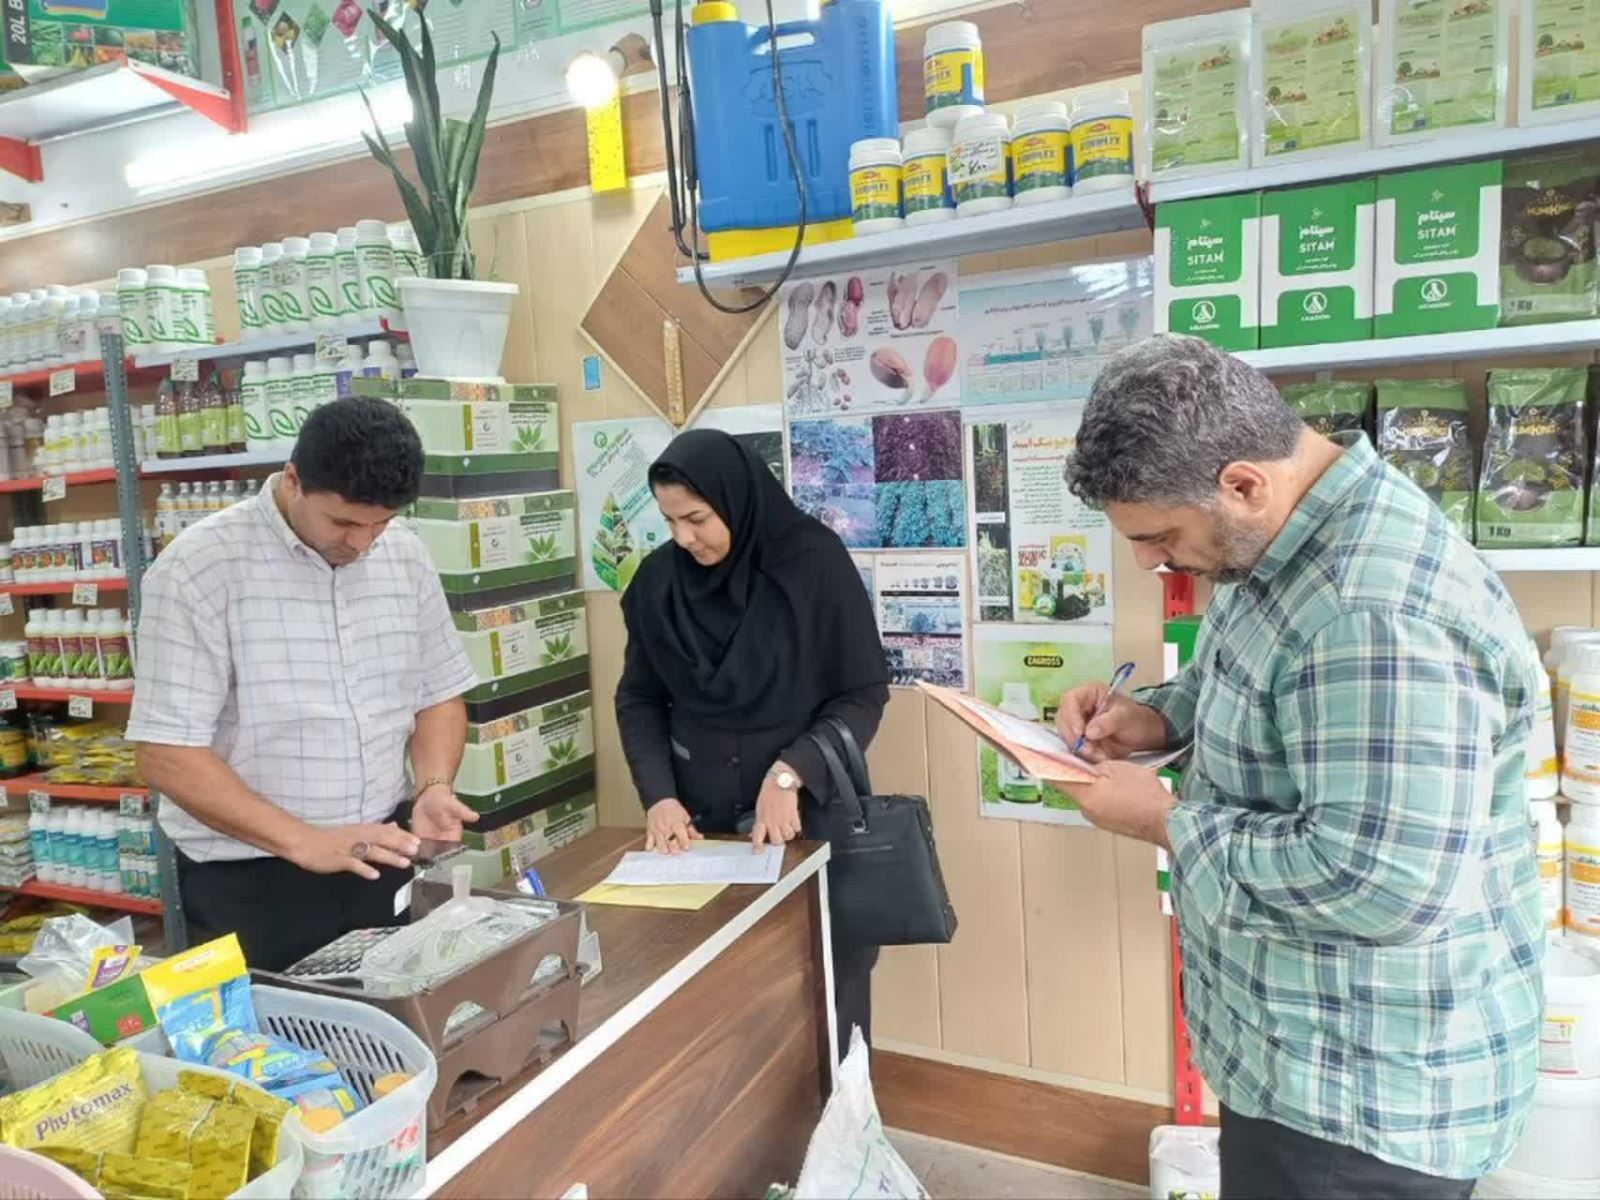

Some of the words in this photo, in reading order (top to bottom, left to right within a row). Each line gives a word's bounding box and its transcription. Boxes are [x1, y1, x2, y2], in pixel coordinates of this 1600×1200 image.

[9, 15, 26, 44] 20L
[1417, 210, 1456, 226] سیتام
[1299, 225, 1334, 240] سیتام
[1417, 226, 1456, 240] SITAM
[1187, 236, 1224, 250] سیتام
[1299, 241, 1335, 254] SITAM
[1187, 252, 1224, 266] SITAM
[1489, 526, 1495, 536] 1
[1017, 550, 1047, 560] HUMIC
[1017, 558, 1039, 567] ACID
[36, 1083, 132, 1141] Phytomax
